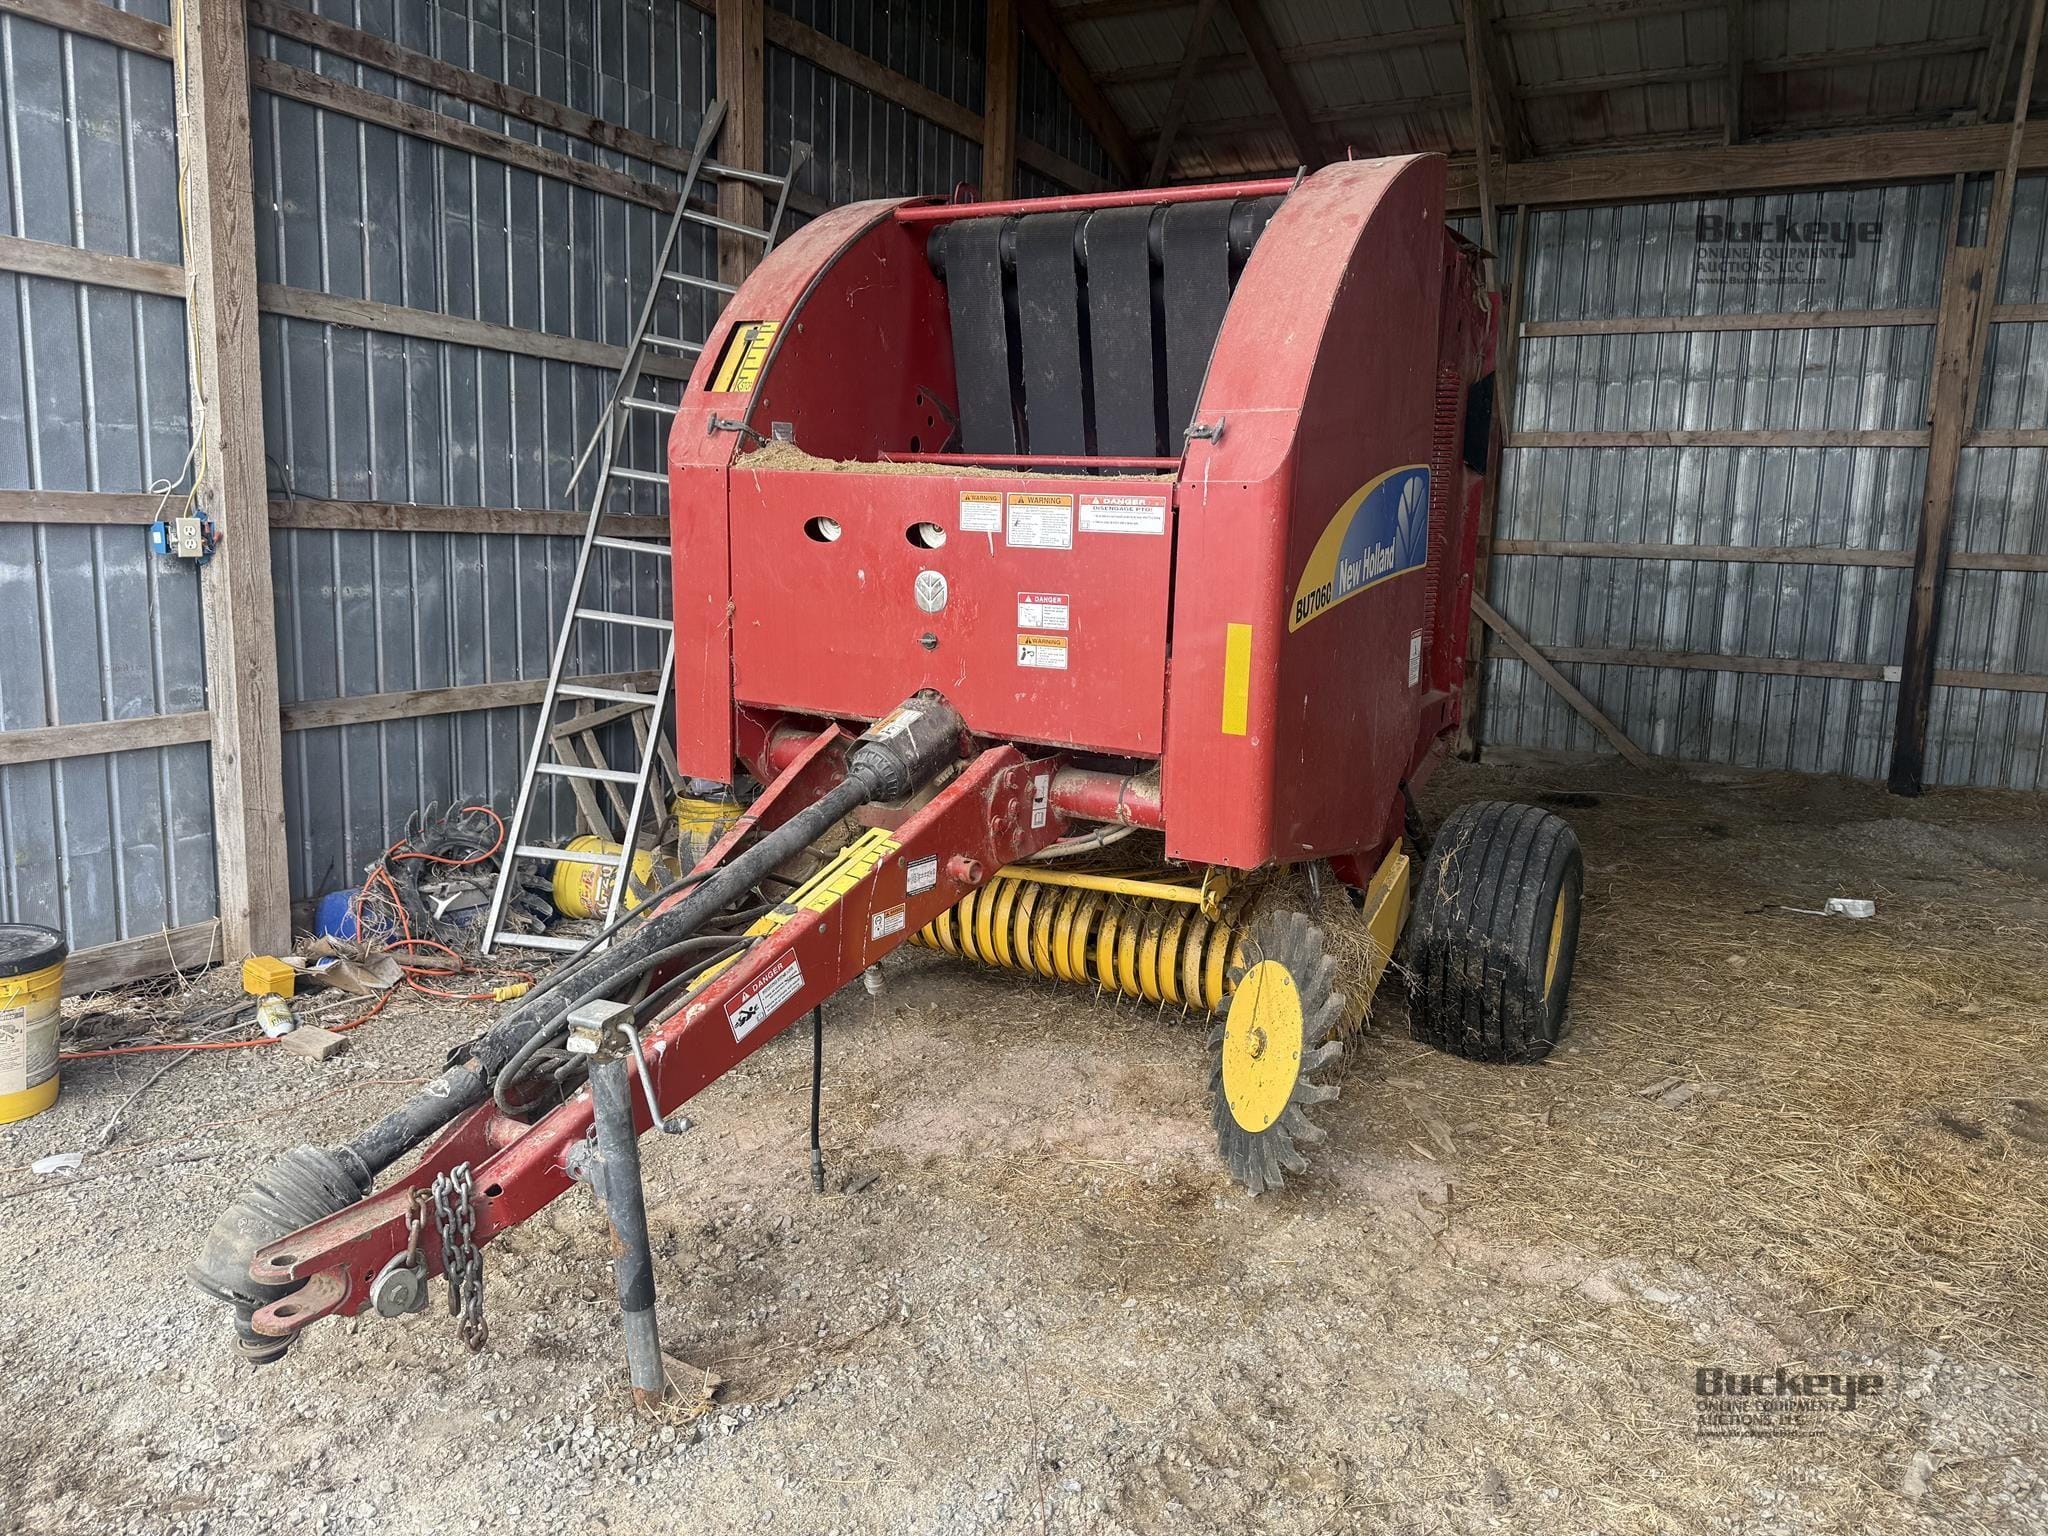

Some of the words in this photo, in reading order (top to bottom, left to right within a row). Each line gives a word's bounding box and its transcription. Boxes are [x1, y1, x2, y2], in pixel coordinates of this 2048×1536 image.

[1027, 496, 1061, 504] WARNING
[1103, 497, 1146, 505] DANGER
[1338, 559, 1361, 595] New
[1362, 537, 1396, 582] Holland
[1034, 595, 1061, 604] DANGER
[1295, 581, 1332, 624] BU7060
[1031, 638, 1061, 646] WARNING
[751, 962, 784, 992] DANGER
